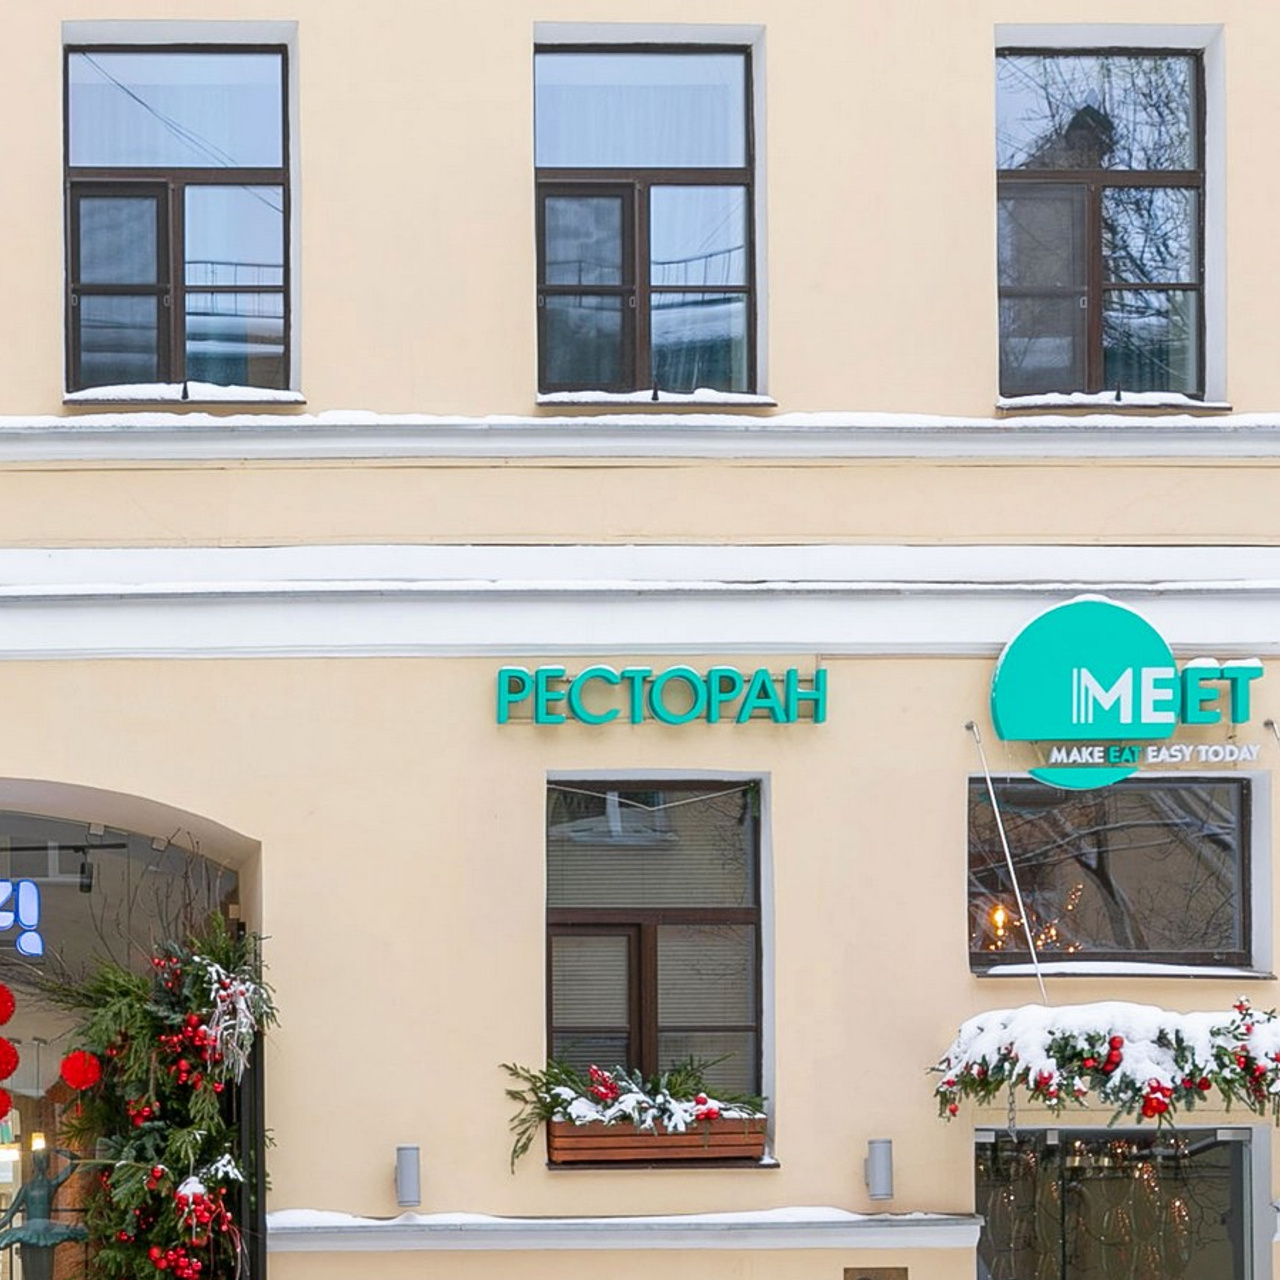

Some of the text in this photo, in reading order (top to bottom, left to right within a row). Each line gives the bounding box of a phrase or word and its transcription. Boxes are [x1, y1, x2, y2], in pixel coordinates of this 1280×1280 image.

[497, 665, 827, 725] РЕСТОРАН
[1072, 666, 1264, 724] MEET
[1050, 744, 1261, 763] MAKE EAT EASY TODAY
